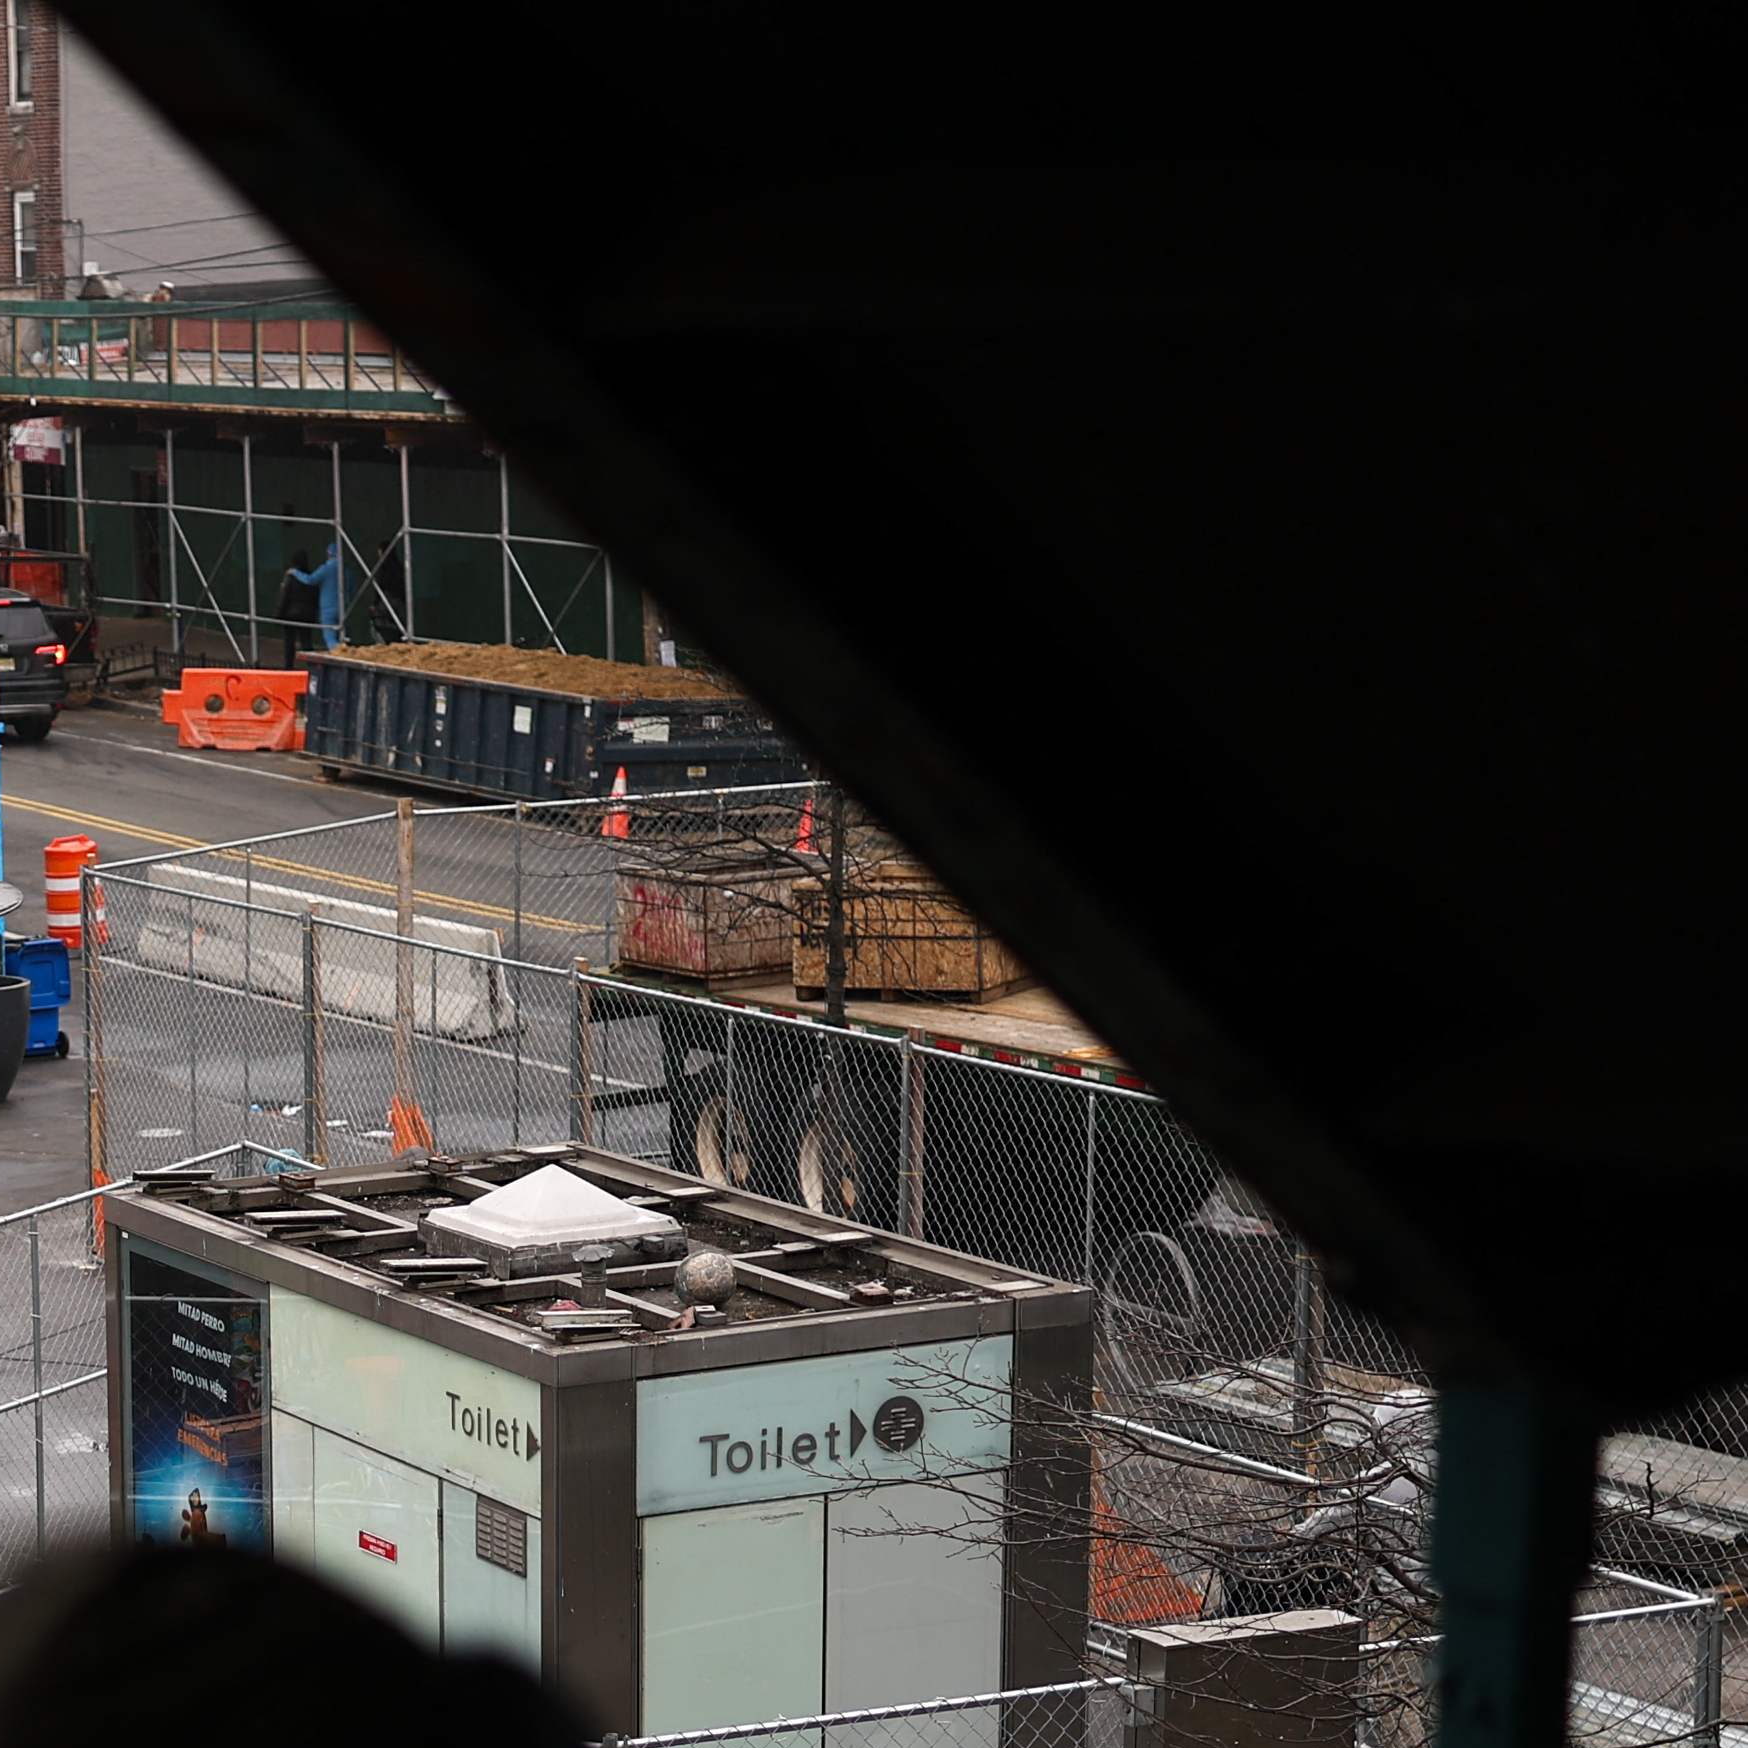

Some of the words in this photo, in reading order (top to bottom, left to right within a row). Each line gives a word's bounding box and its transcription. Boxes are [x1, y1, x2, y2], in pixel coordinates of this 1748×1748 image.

[178, 1301, 200, 1322] MITAD
[201, 1312, 225, 1333] PERRO
[172, 1333, 194, 1354] MITAD
[171, 1366, 194, 1386] TODO
[196, 1376, 208, 1390] UN
[446, 1391, 520, 1457] Toilet
[700, 1422, 841, 1478] Toilet
